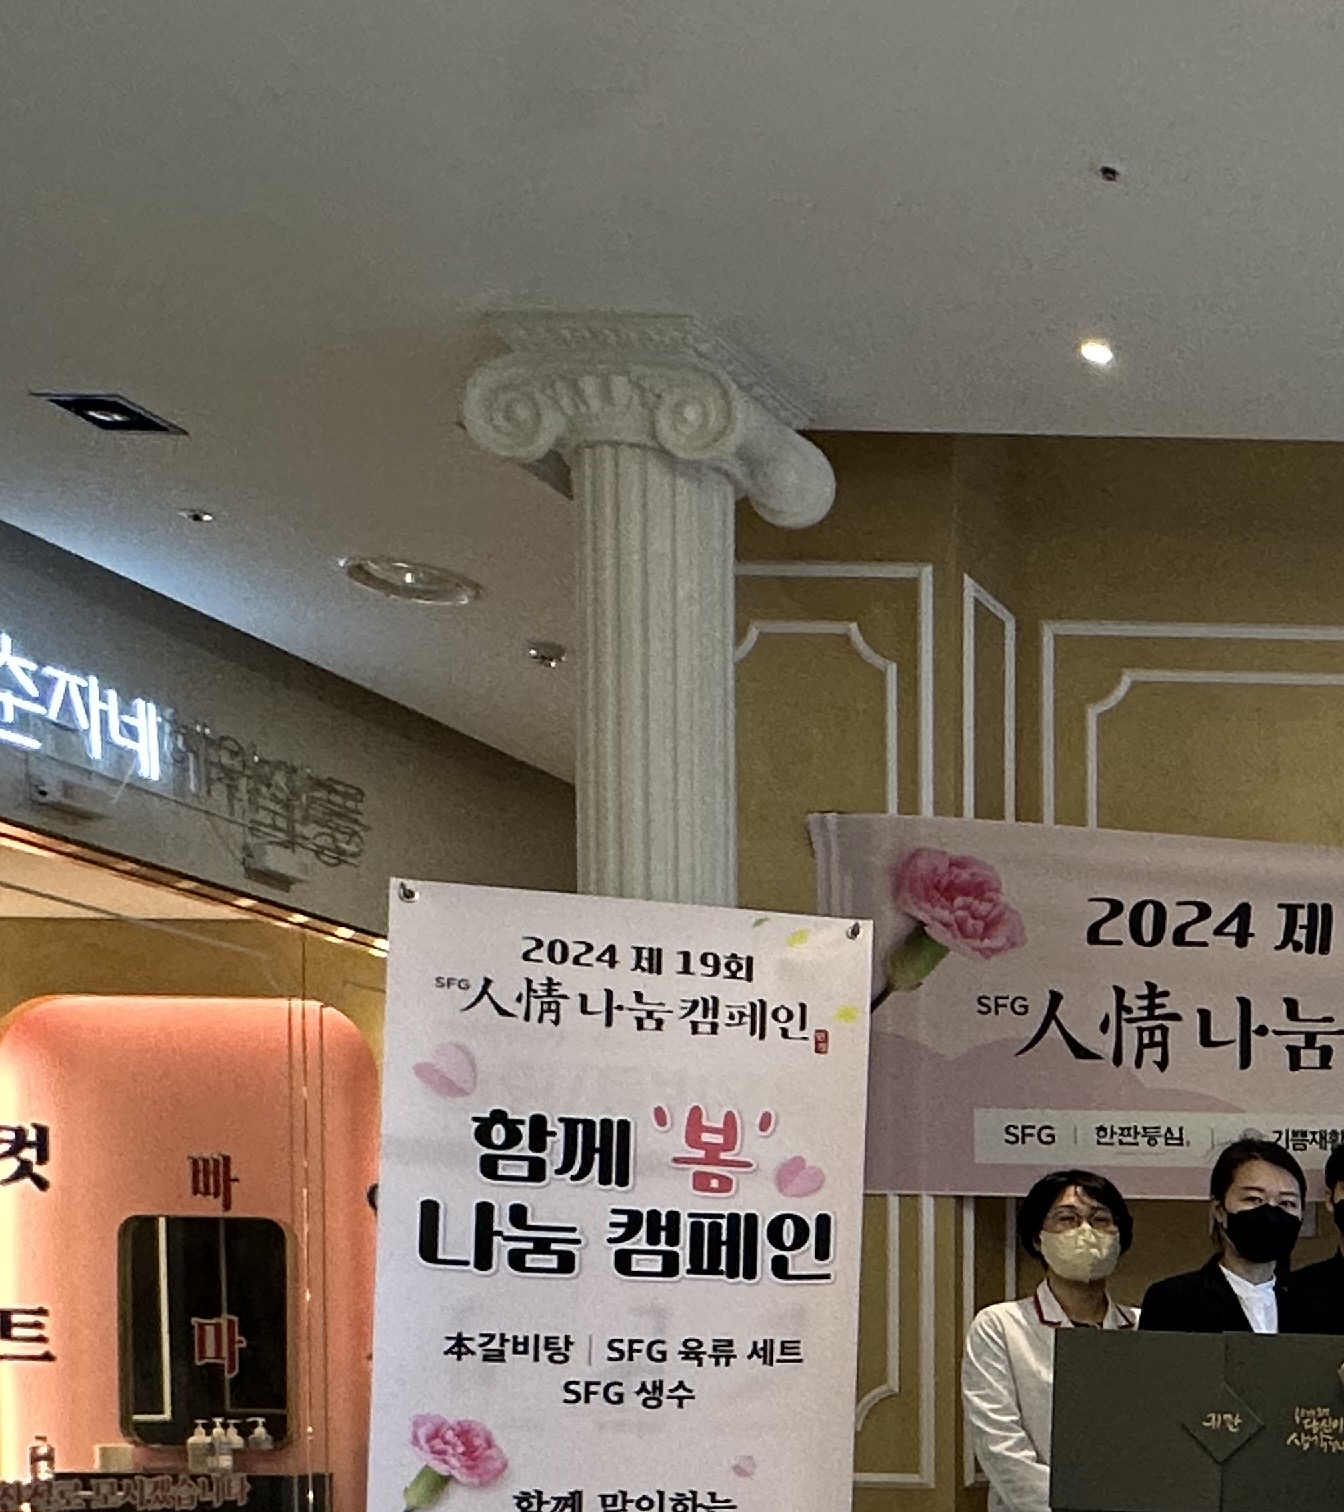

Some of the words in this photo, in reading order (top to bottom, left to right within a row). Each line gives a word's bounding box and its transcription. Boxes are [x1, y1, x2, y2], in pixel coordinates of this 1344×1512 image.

[1086, 897, 1256, 950] 2024
[1276, 902, 1332, 956] 제
[520, 936, 620, 969] 2024
[631, 945, 663, 976] 제
[675, 950, 755, 983] 19회
[434, 975, 471, 992] SFG
[977, 995, 1029, 1017] SFG
[471, 1107, 631, 1189] 함께
[1003, 1123, 1056, 1147] SFG
[418, 1197, 583, 1275] 나눔
[606, 1207, 833, 1282] 캠페인
[443, 1332, 575, 1366] 本갈비탕
[606, 1338, 668, 1364] SFG
[677, 1338, 738, 1368] 육류
[746, 1338, 804, 1367] 세트
[562, 1380, 625, 1405] SFG
[634, 1378, 696, 1410] 생수
